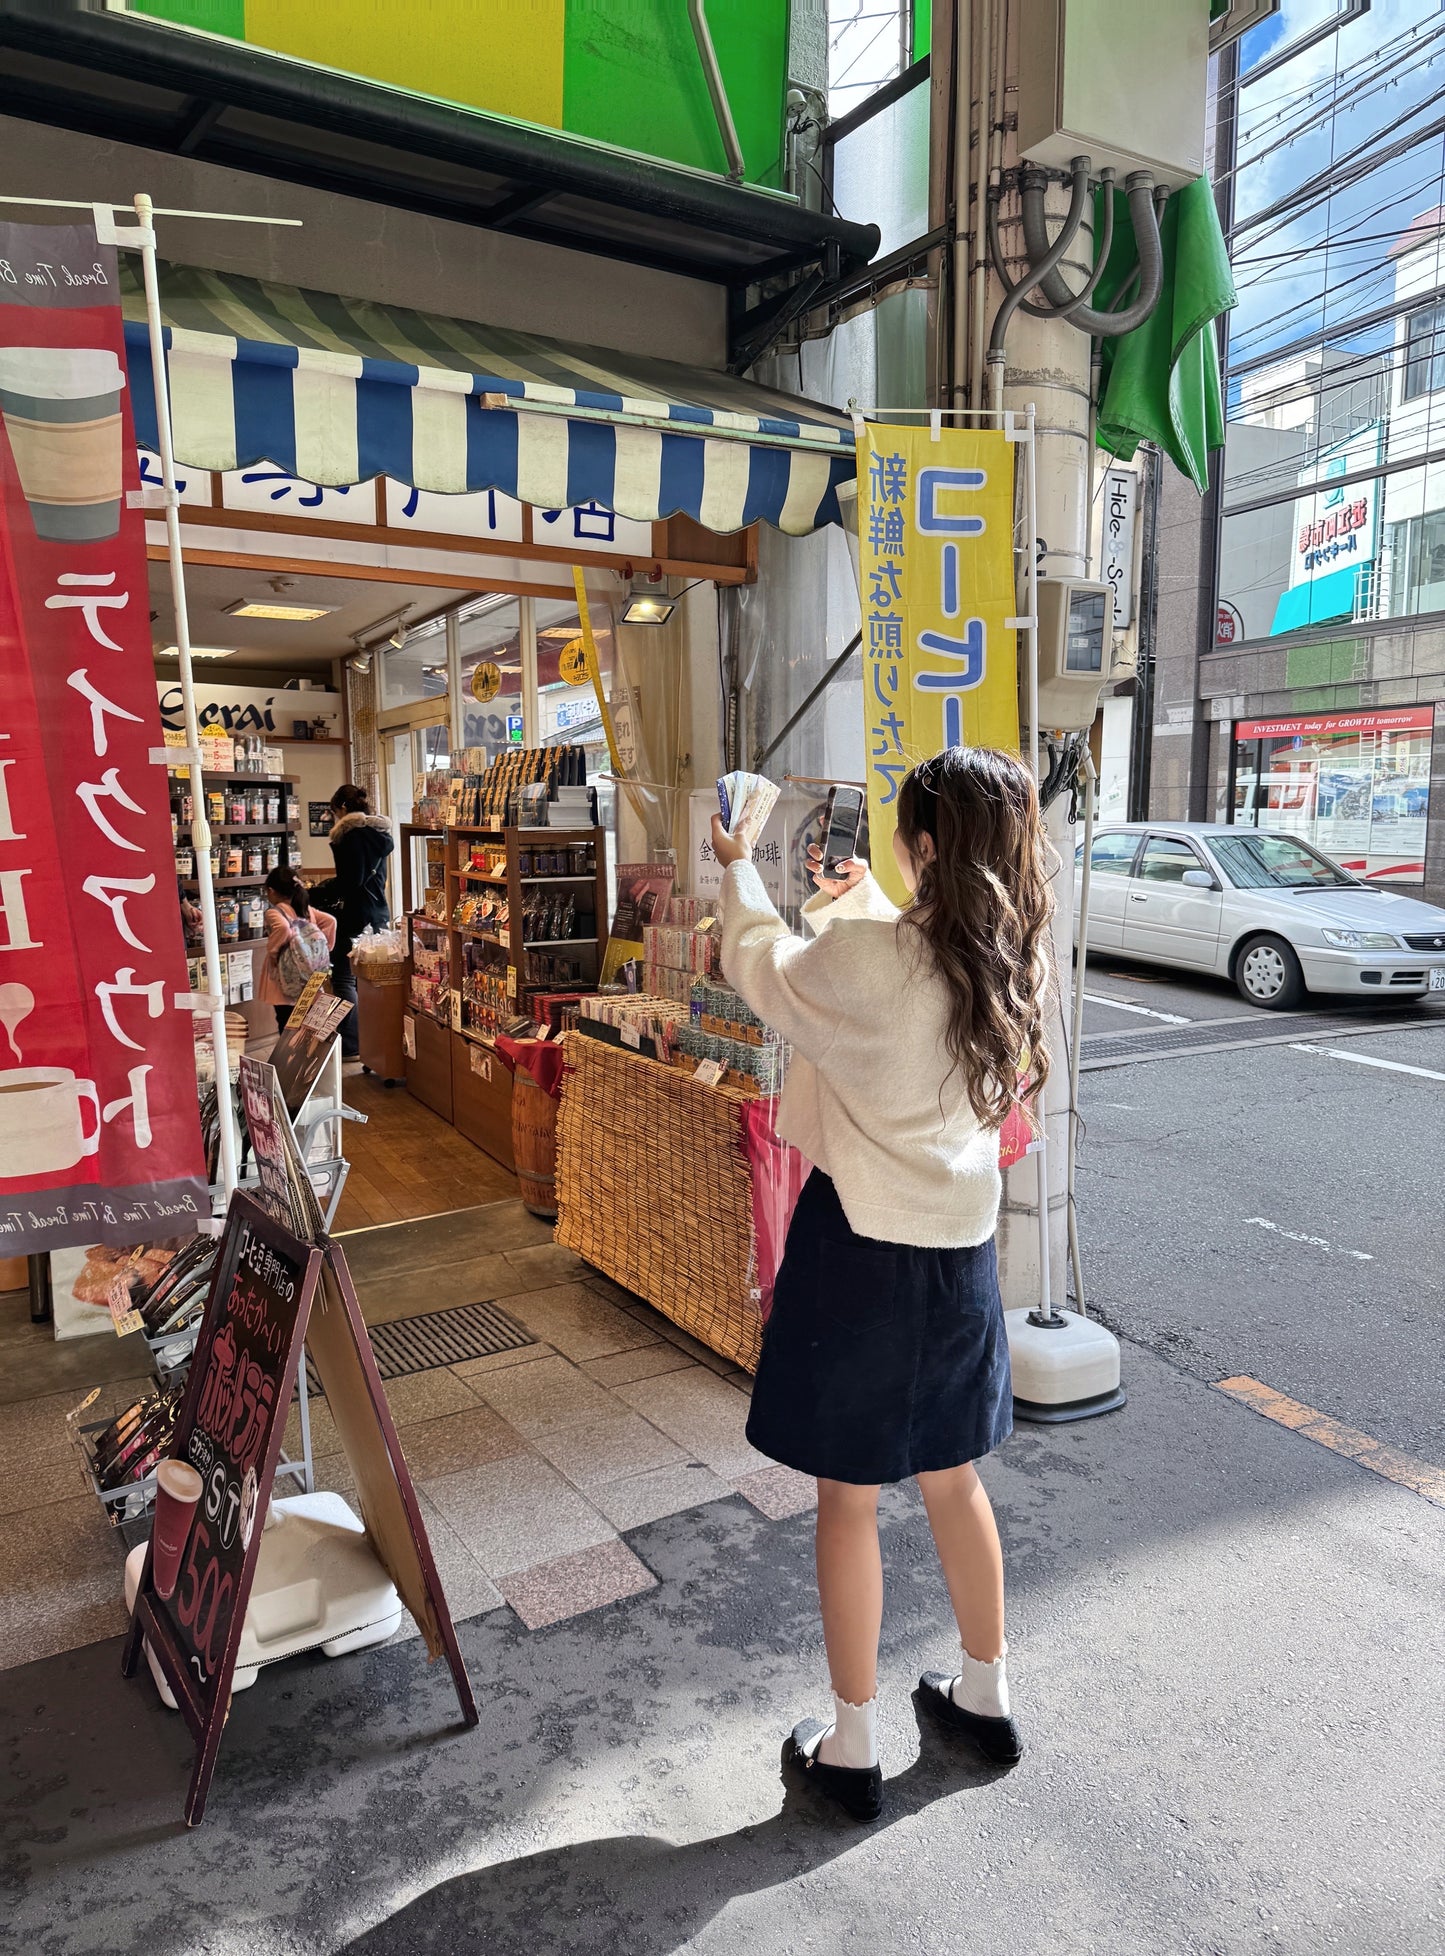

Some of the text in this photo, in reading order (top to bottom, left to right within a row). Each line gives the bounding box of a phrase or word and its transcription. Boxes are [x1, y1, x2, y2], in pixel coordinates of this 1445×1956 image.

[511, 718, 523, 732] P
[1253, 715, 1413, 734] INVESTMENT today for GROWTH tomorrow
[699, 837, 782, 867] 金珈琲
